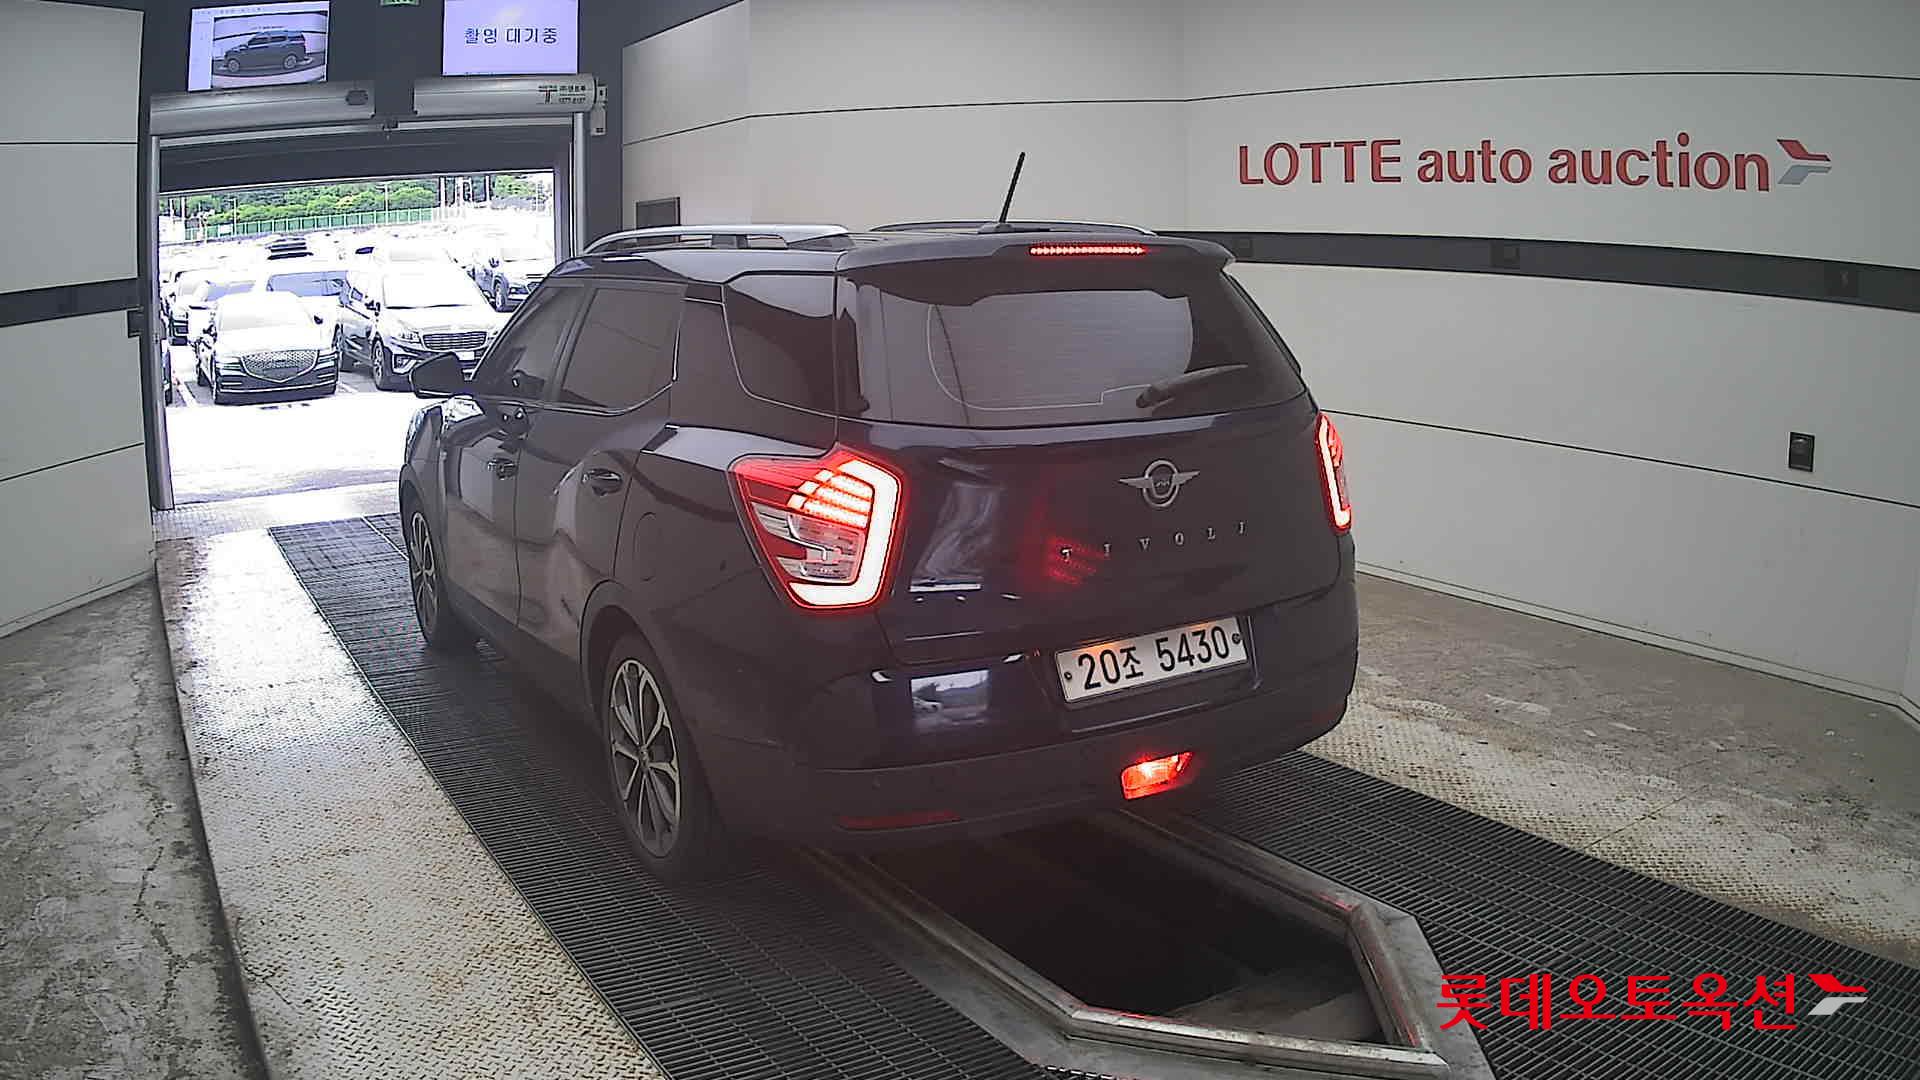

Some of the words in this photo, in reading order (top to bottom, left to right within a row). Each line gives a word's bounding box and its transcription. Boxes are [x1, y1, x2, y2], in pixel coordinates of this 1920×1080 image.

[464, 27, 498, 45] 촬영
[505, 27, 558, 45] 대기중
[1239, 140, 1400, 186] LOTTE
[1417, 139, 1533, 185] auto
[1548, 132, 1770, 191] auction
[1059, 520, 1247, 562] TIVOLI
[1077, 646, 1145, 691] 20조
[1155, 625, 1231, 673] 5430
